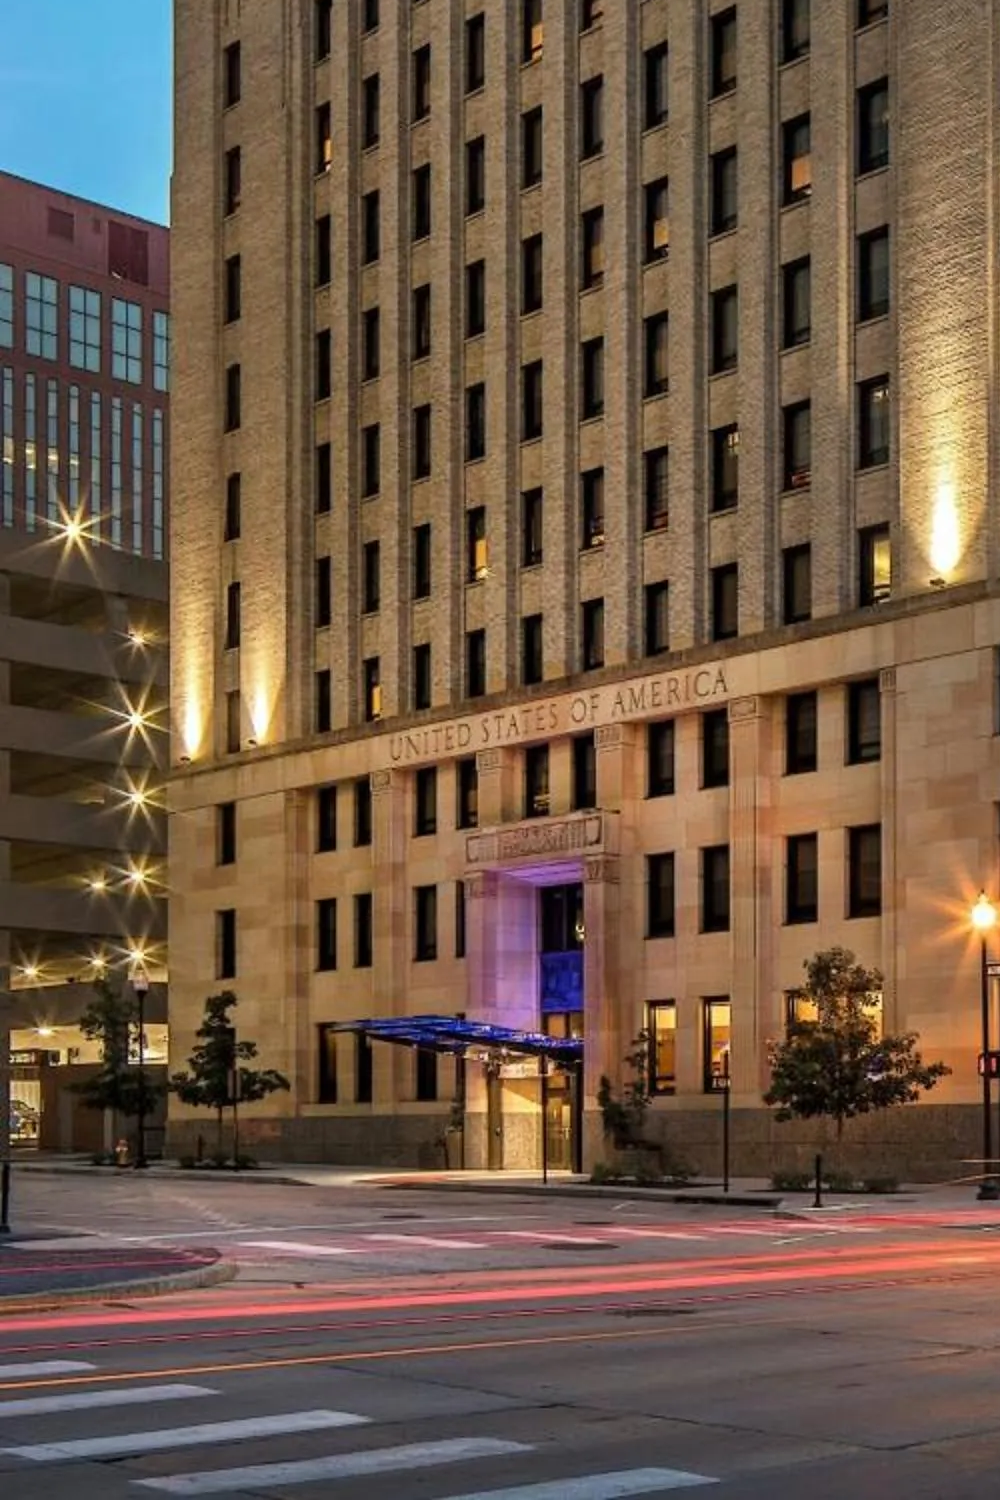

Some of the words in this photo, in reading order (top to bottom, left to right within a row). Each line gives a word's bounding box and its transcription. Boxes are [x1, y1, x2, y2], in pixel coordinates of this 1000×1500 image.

[389, 723, 472, 761] UNITED
[481, 705, 558, 743] STATES
[571, 694, 600, 723] OF
[611, 667, 729, 715] AMERICA
